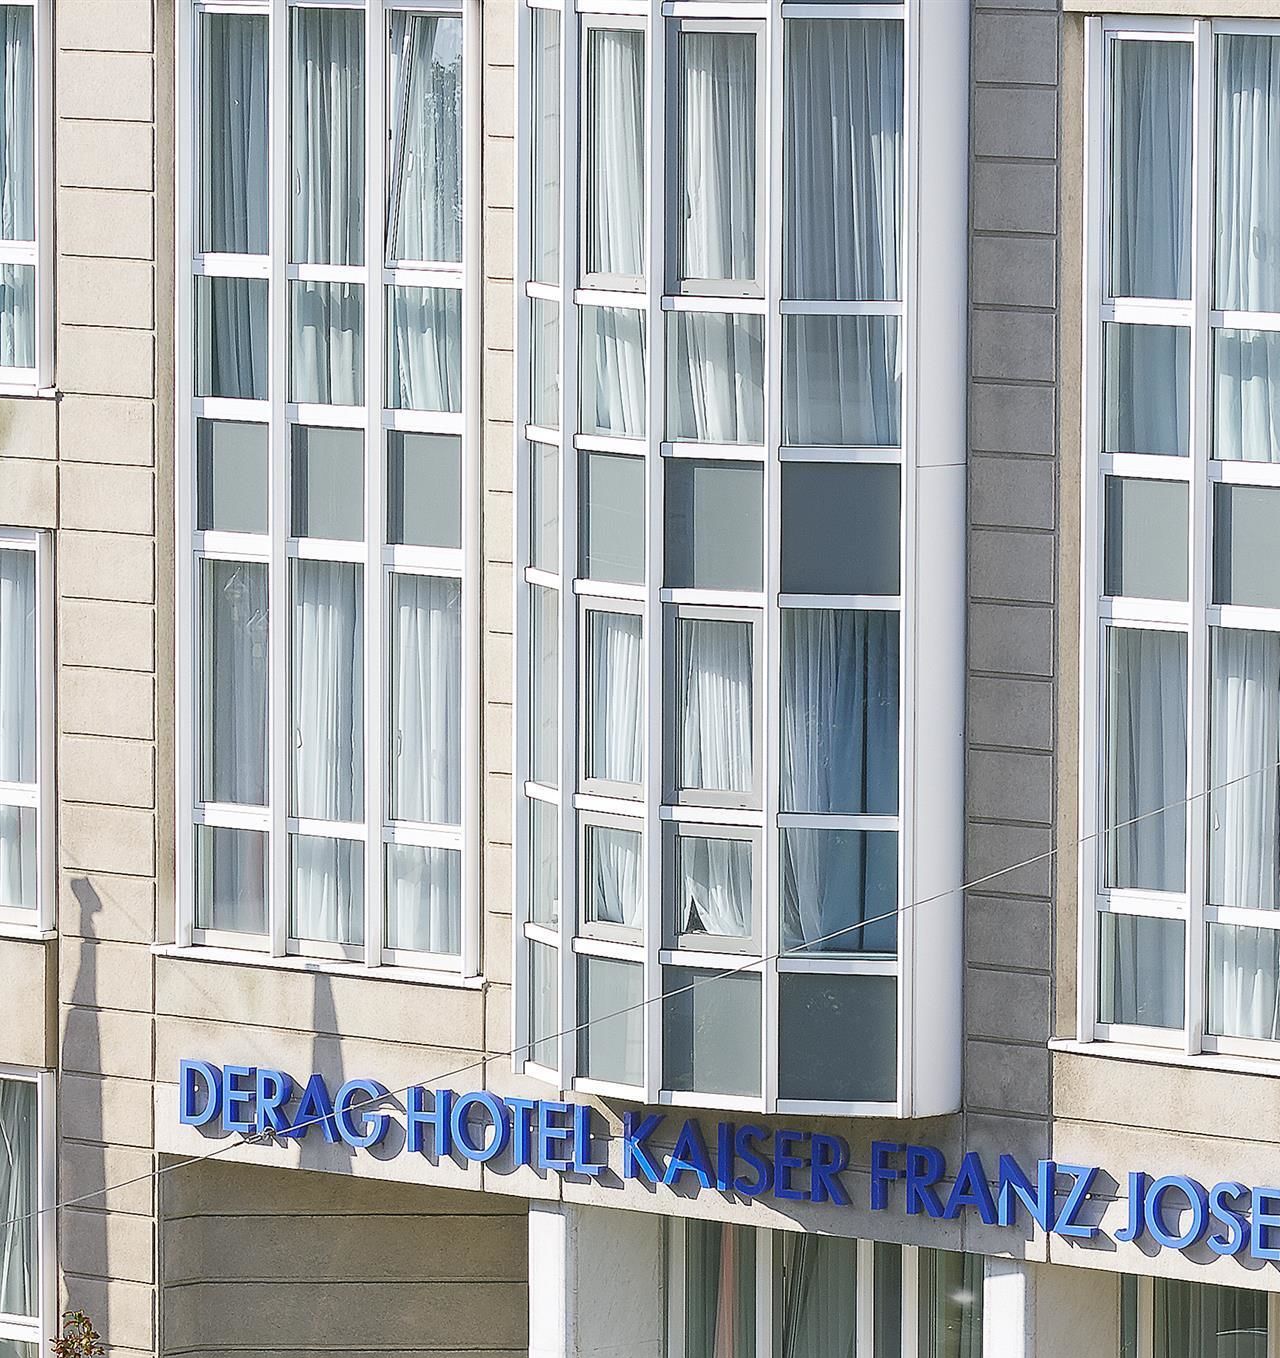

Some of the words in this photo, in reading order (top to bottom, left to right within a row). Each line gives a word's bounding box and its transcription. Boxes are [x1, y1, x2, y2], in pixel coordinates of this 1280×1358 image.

[178, 1058, 390, 1149] DERAG
[405, 1085, 609, 1176] HOTEL
[622, 1110, 851, 1207] KAISER
[870, 1141, 1101, 1239] FRANZ
